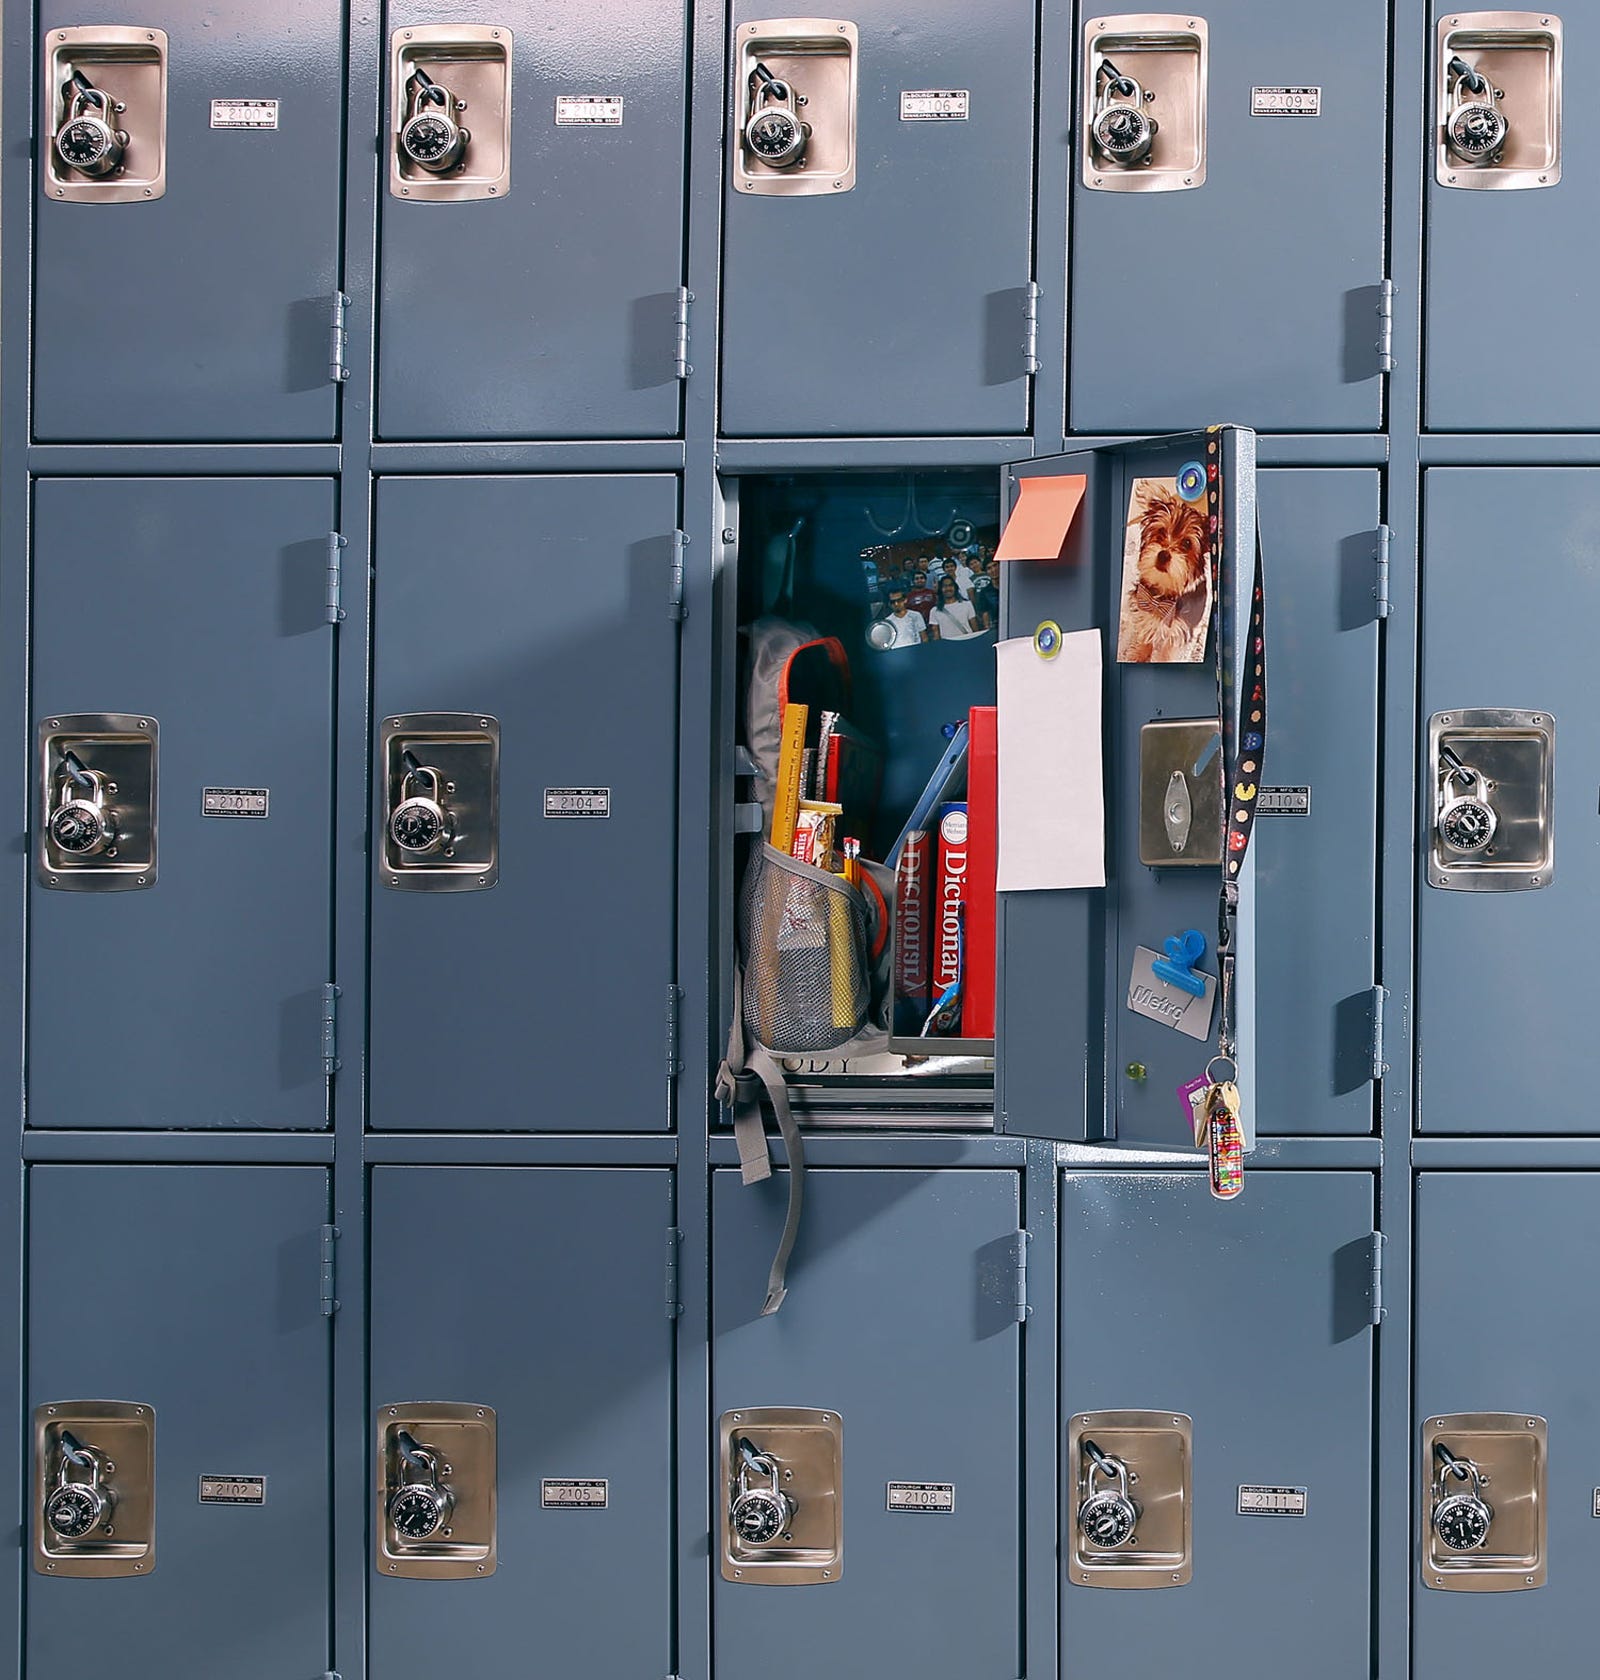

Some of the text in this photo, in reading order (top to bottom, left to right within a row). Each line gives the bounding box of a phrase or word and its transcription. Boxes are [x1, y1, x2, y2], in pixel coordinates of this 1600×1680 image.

[919, 100, 950, 111] 2106
[1270, 96, 1302, 107] 2109
[229, 108, 260, 120] 2100
[575, 105, 605, 117] 2103
[220, 796, 250, 809] 2101
[561, 797, 592, 809] 2104
[1260, 795, 1292, 806] 2110
[934, 850, 967, 991] Dictionary
[1132, 985, 1184, 1020] Metro
[217, 1484, 248, 1496] 2102
[559, 1488, 590, 1500] 2105
[905, 1492, 936, 1504] 2108
[1256, 1495, 1286, 1507] 2111
